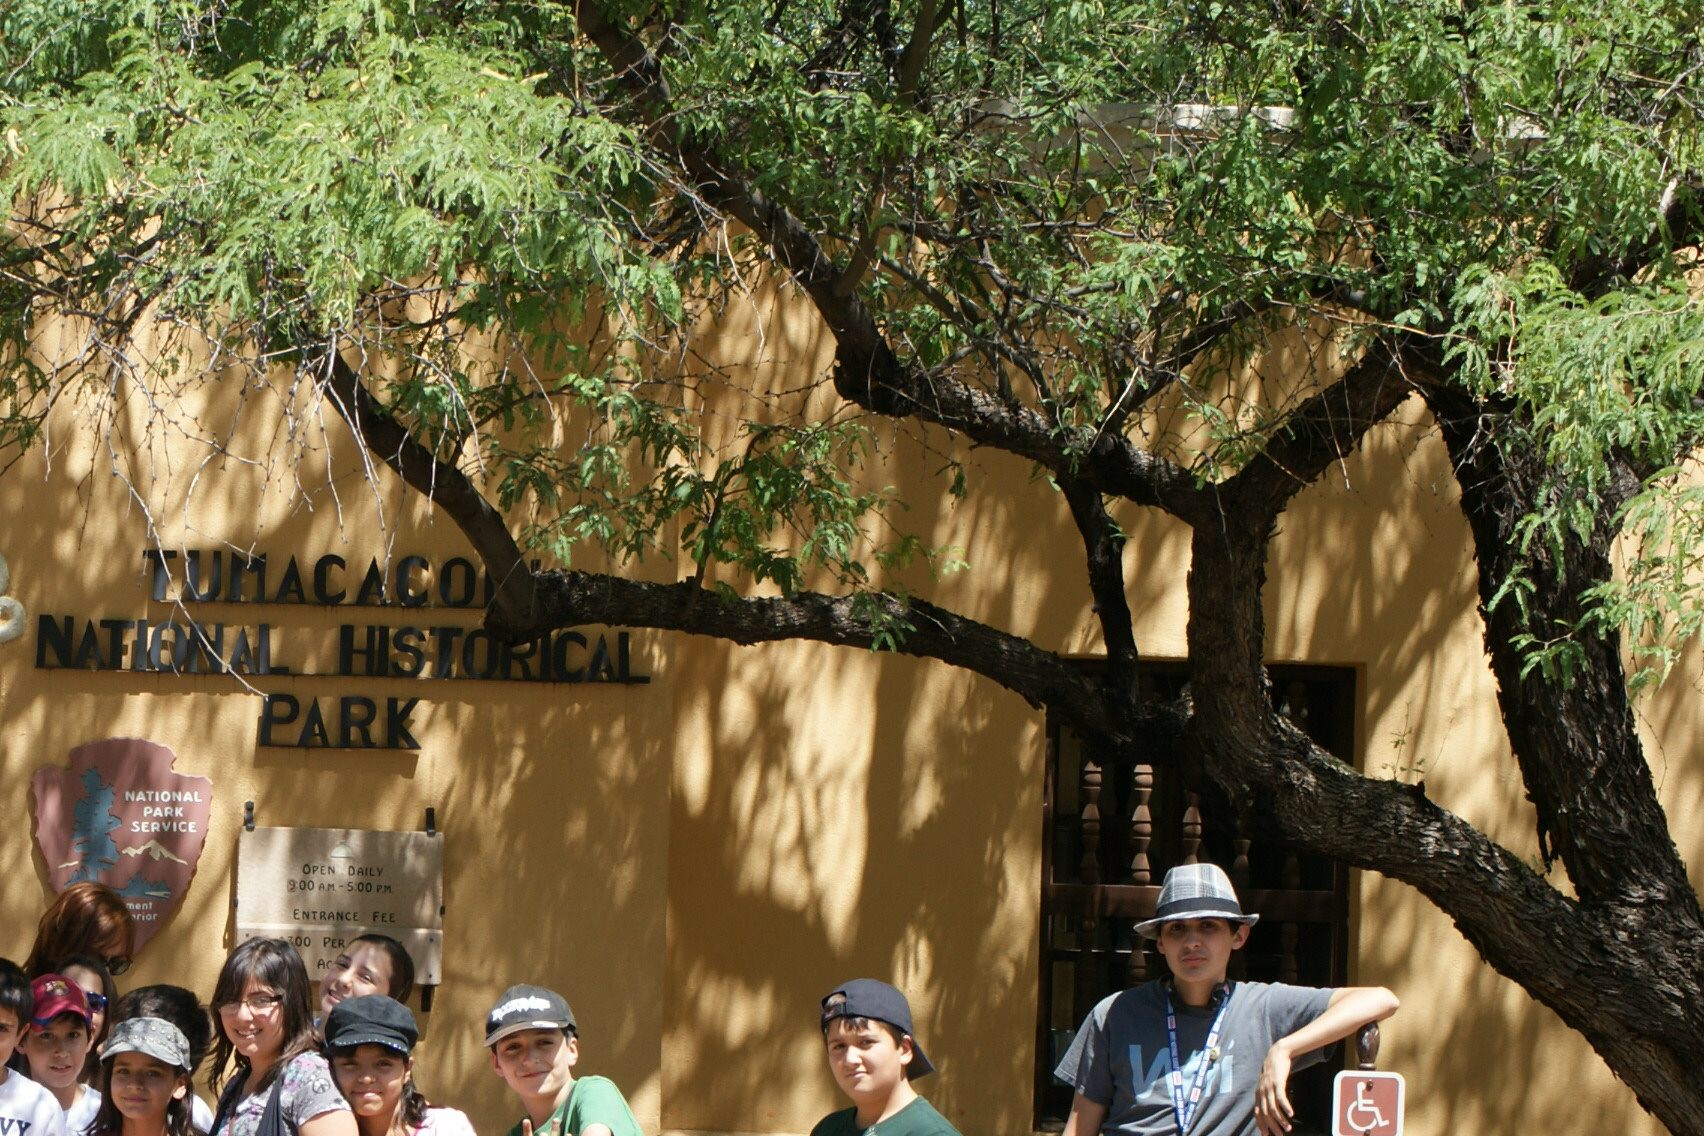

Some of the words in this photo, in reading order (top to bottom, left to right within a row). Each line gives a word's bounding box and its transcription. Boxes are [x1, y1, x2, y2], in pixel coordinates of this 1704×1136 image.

[143, 550, 541, 608] TUMACACO
[36, 614, 290, 675] NATIONAL
[339, 624, 651, 684] HISTORICAL
[259, 693, 422, 750] PARK
[124, 791, 203, 802] NATIONAL
[143, 806, 184, 818] PARK
[130, 821, 197, 833] SERVICE
[302, 863, 336, 876] OPEN
[348, 865, 384, 877] DAILY
[288, 879, 315, 892] 9:00
[347, 881, 373, 893] 5:00
[293, 908, 359, 921] ENTRANCE
[372, 911, 396, 923] FEE
[323, 937, 345, 948] PER
[1128, 1039, 1234, 1101] Wii
